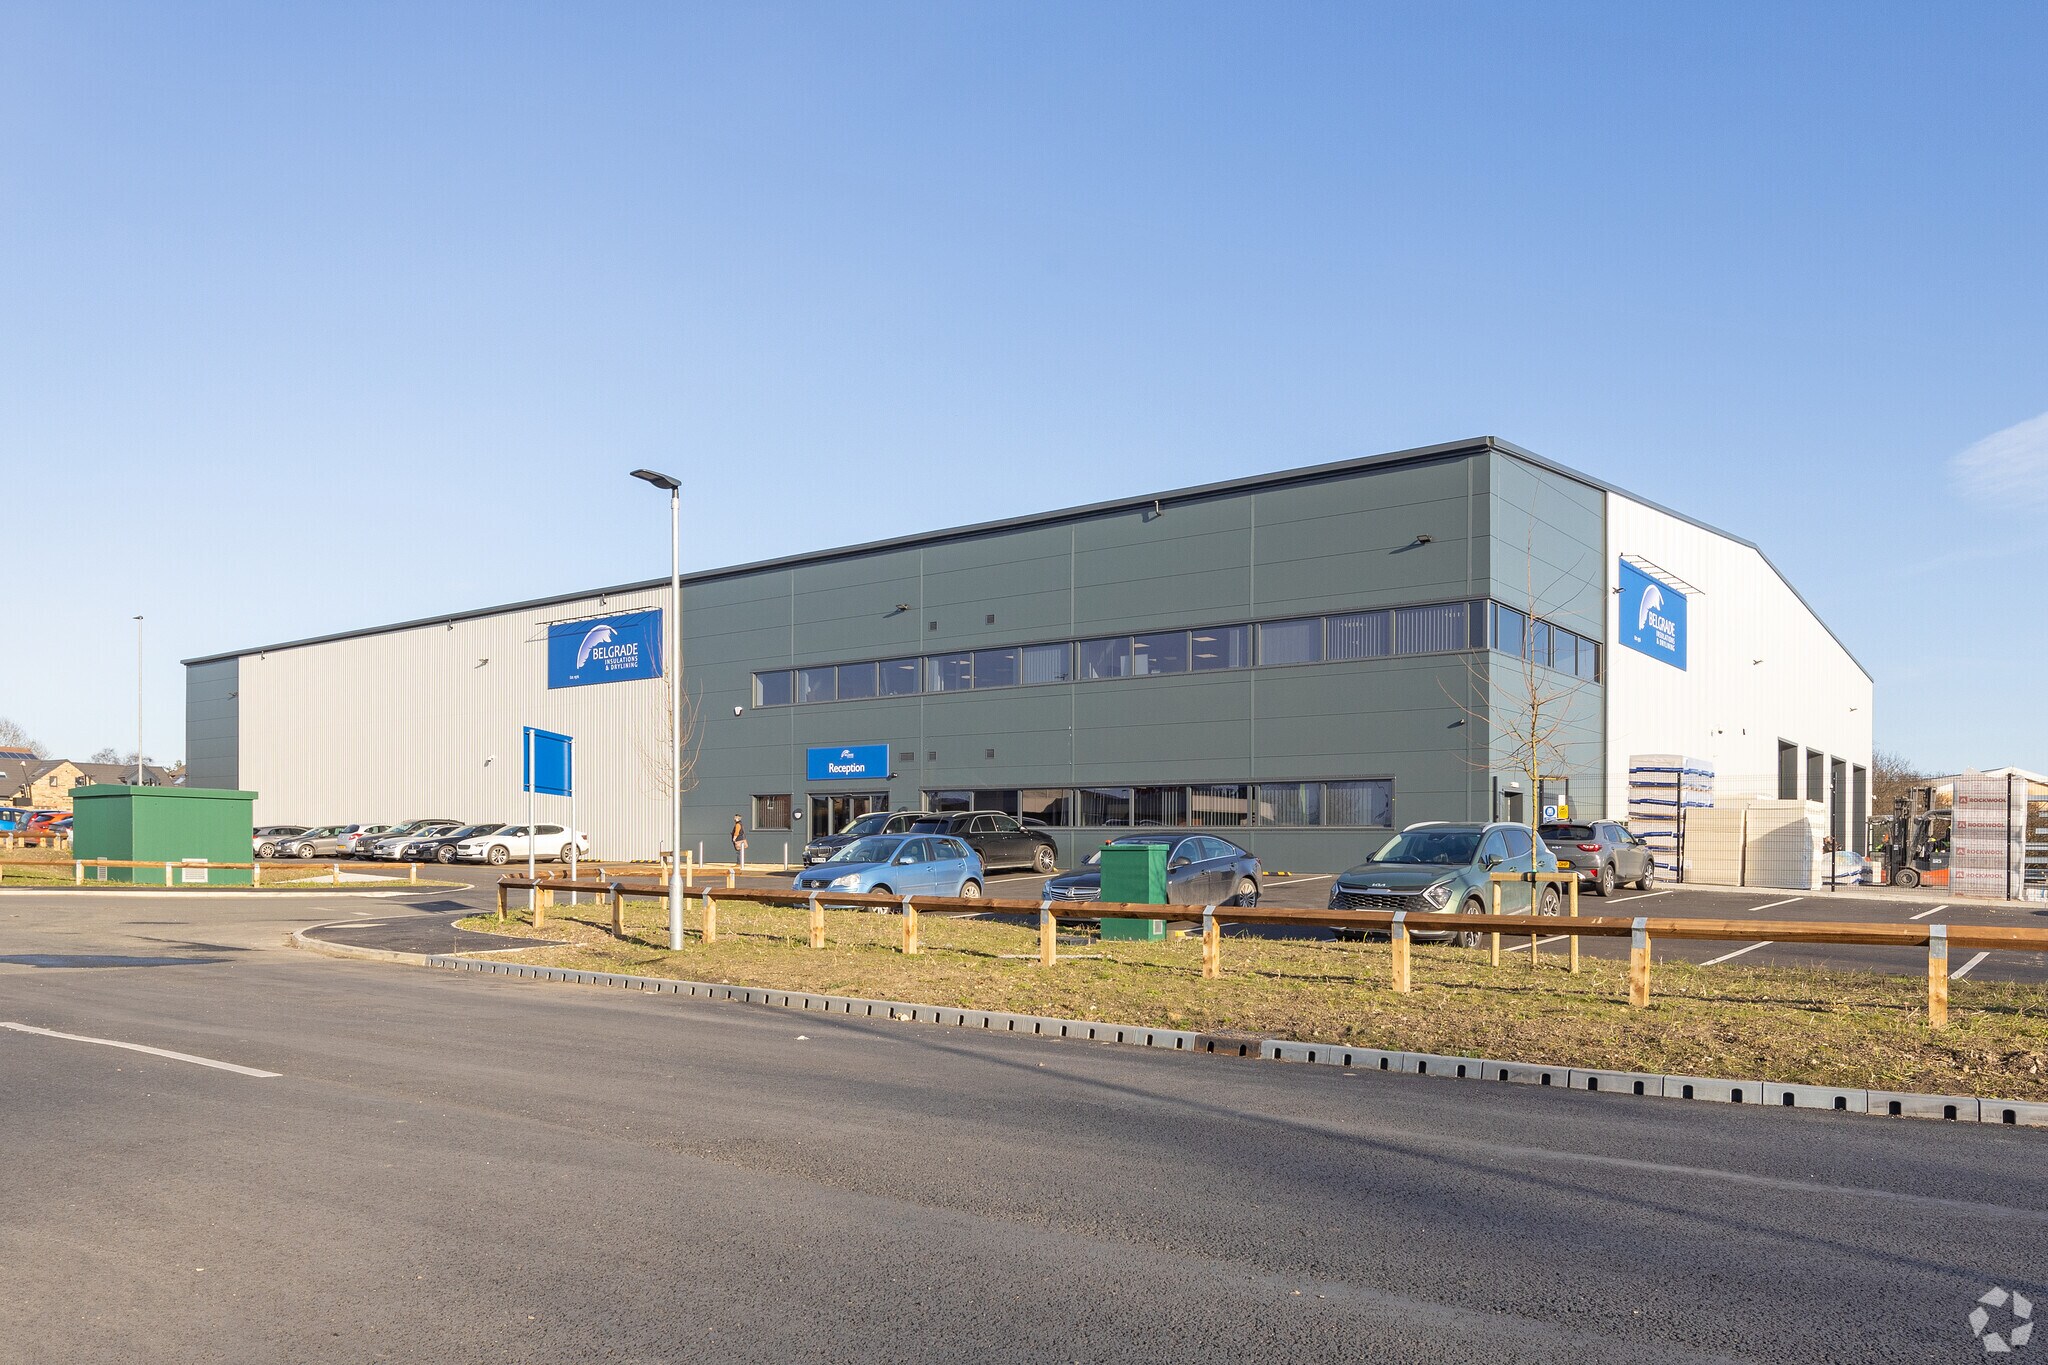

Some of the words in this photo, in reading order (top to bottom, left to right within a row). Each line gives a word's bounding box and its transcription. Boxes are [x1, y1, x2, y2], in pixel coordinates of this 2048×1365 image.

[1648, 611, 1675, 637] BELGRADE
[593, 643, 638, 660] BELGRADE
[605, 656, 638, 665] INSULATIONS
[610, 662, 638, 670] DRYLINING
[828, 763, 865, 775] Reception
